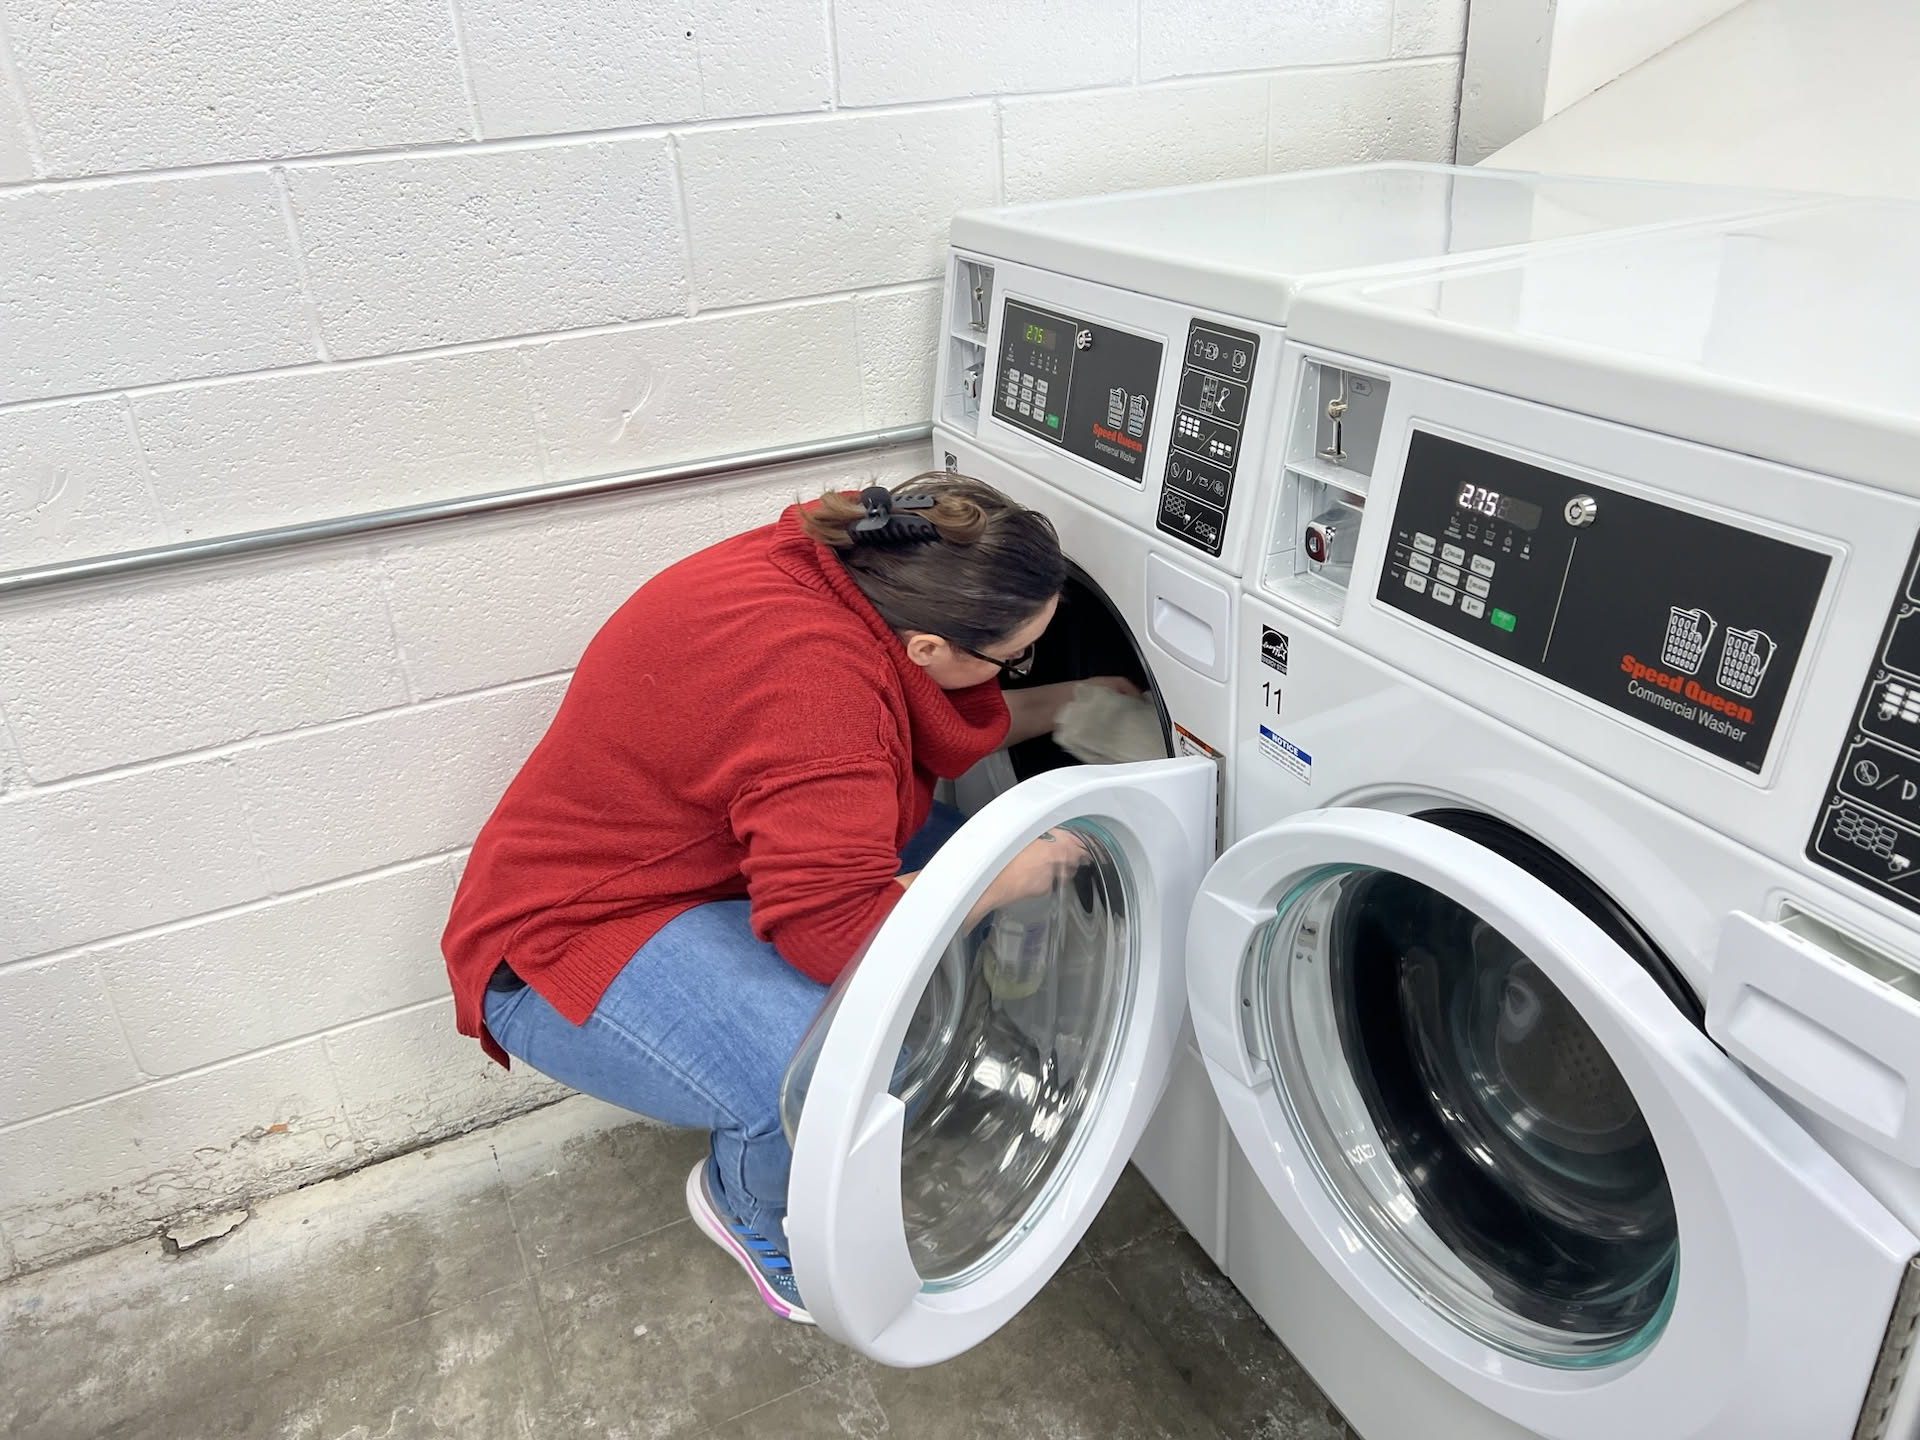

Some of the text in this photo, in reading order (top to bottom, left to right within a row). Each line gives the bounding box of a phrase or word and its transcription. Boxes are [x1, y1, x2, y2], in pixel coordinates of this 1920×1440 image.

[1092, 423, 1143, 453] Speed Queen
[1094, 439, 1137, 464] Commercial Washer
[1459, 483, 1499, 516] 2.75
[1900, 603, 1909, 614] 2
[1876, 669, 1886, 680] 3
[1262, 681, 1282, 715] 11
[1620, 654, 1753, 724] Speed Queen
[1627, 680, 1747, 743] Commercial Washer
[1272, 733, 1299, 757] NOTICE
[1832, 795, 1841, 805] 5
